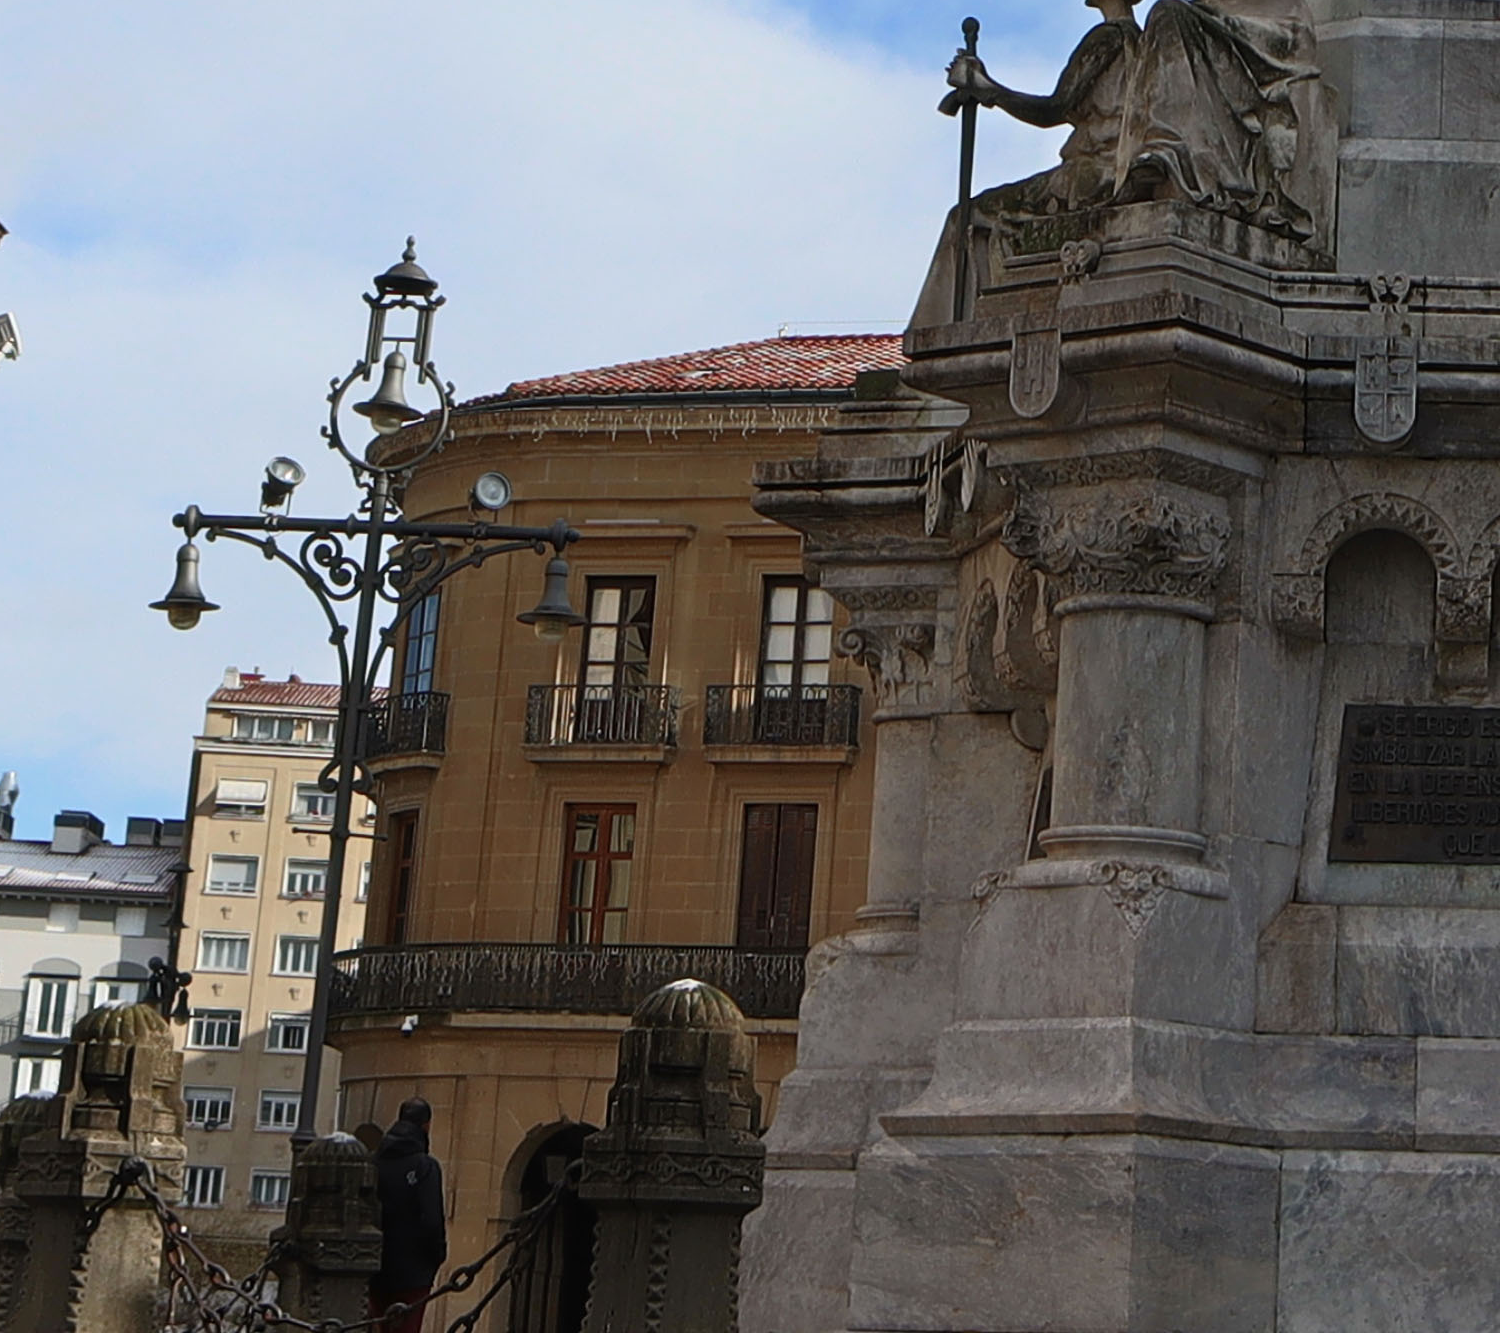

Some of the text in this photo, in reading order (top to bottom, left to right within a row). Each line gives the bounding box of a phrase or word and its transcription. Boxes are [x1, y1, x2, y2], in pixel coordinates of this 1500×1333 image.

[1380, 712, 1407, 736] SE
[1349, 742, 1465, 766] SIMBOLIZAR
[1470, 746, 1499, 768] LA
[1348, 771, 1378, 793] EN
[1387, 773, 1411, 794] LA
[1351, 800, 1470, 824] LIBERTADES
[1443, 833, 1485, 858] QUE
